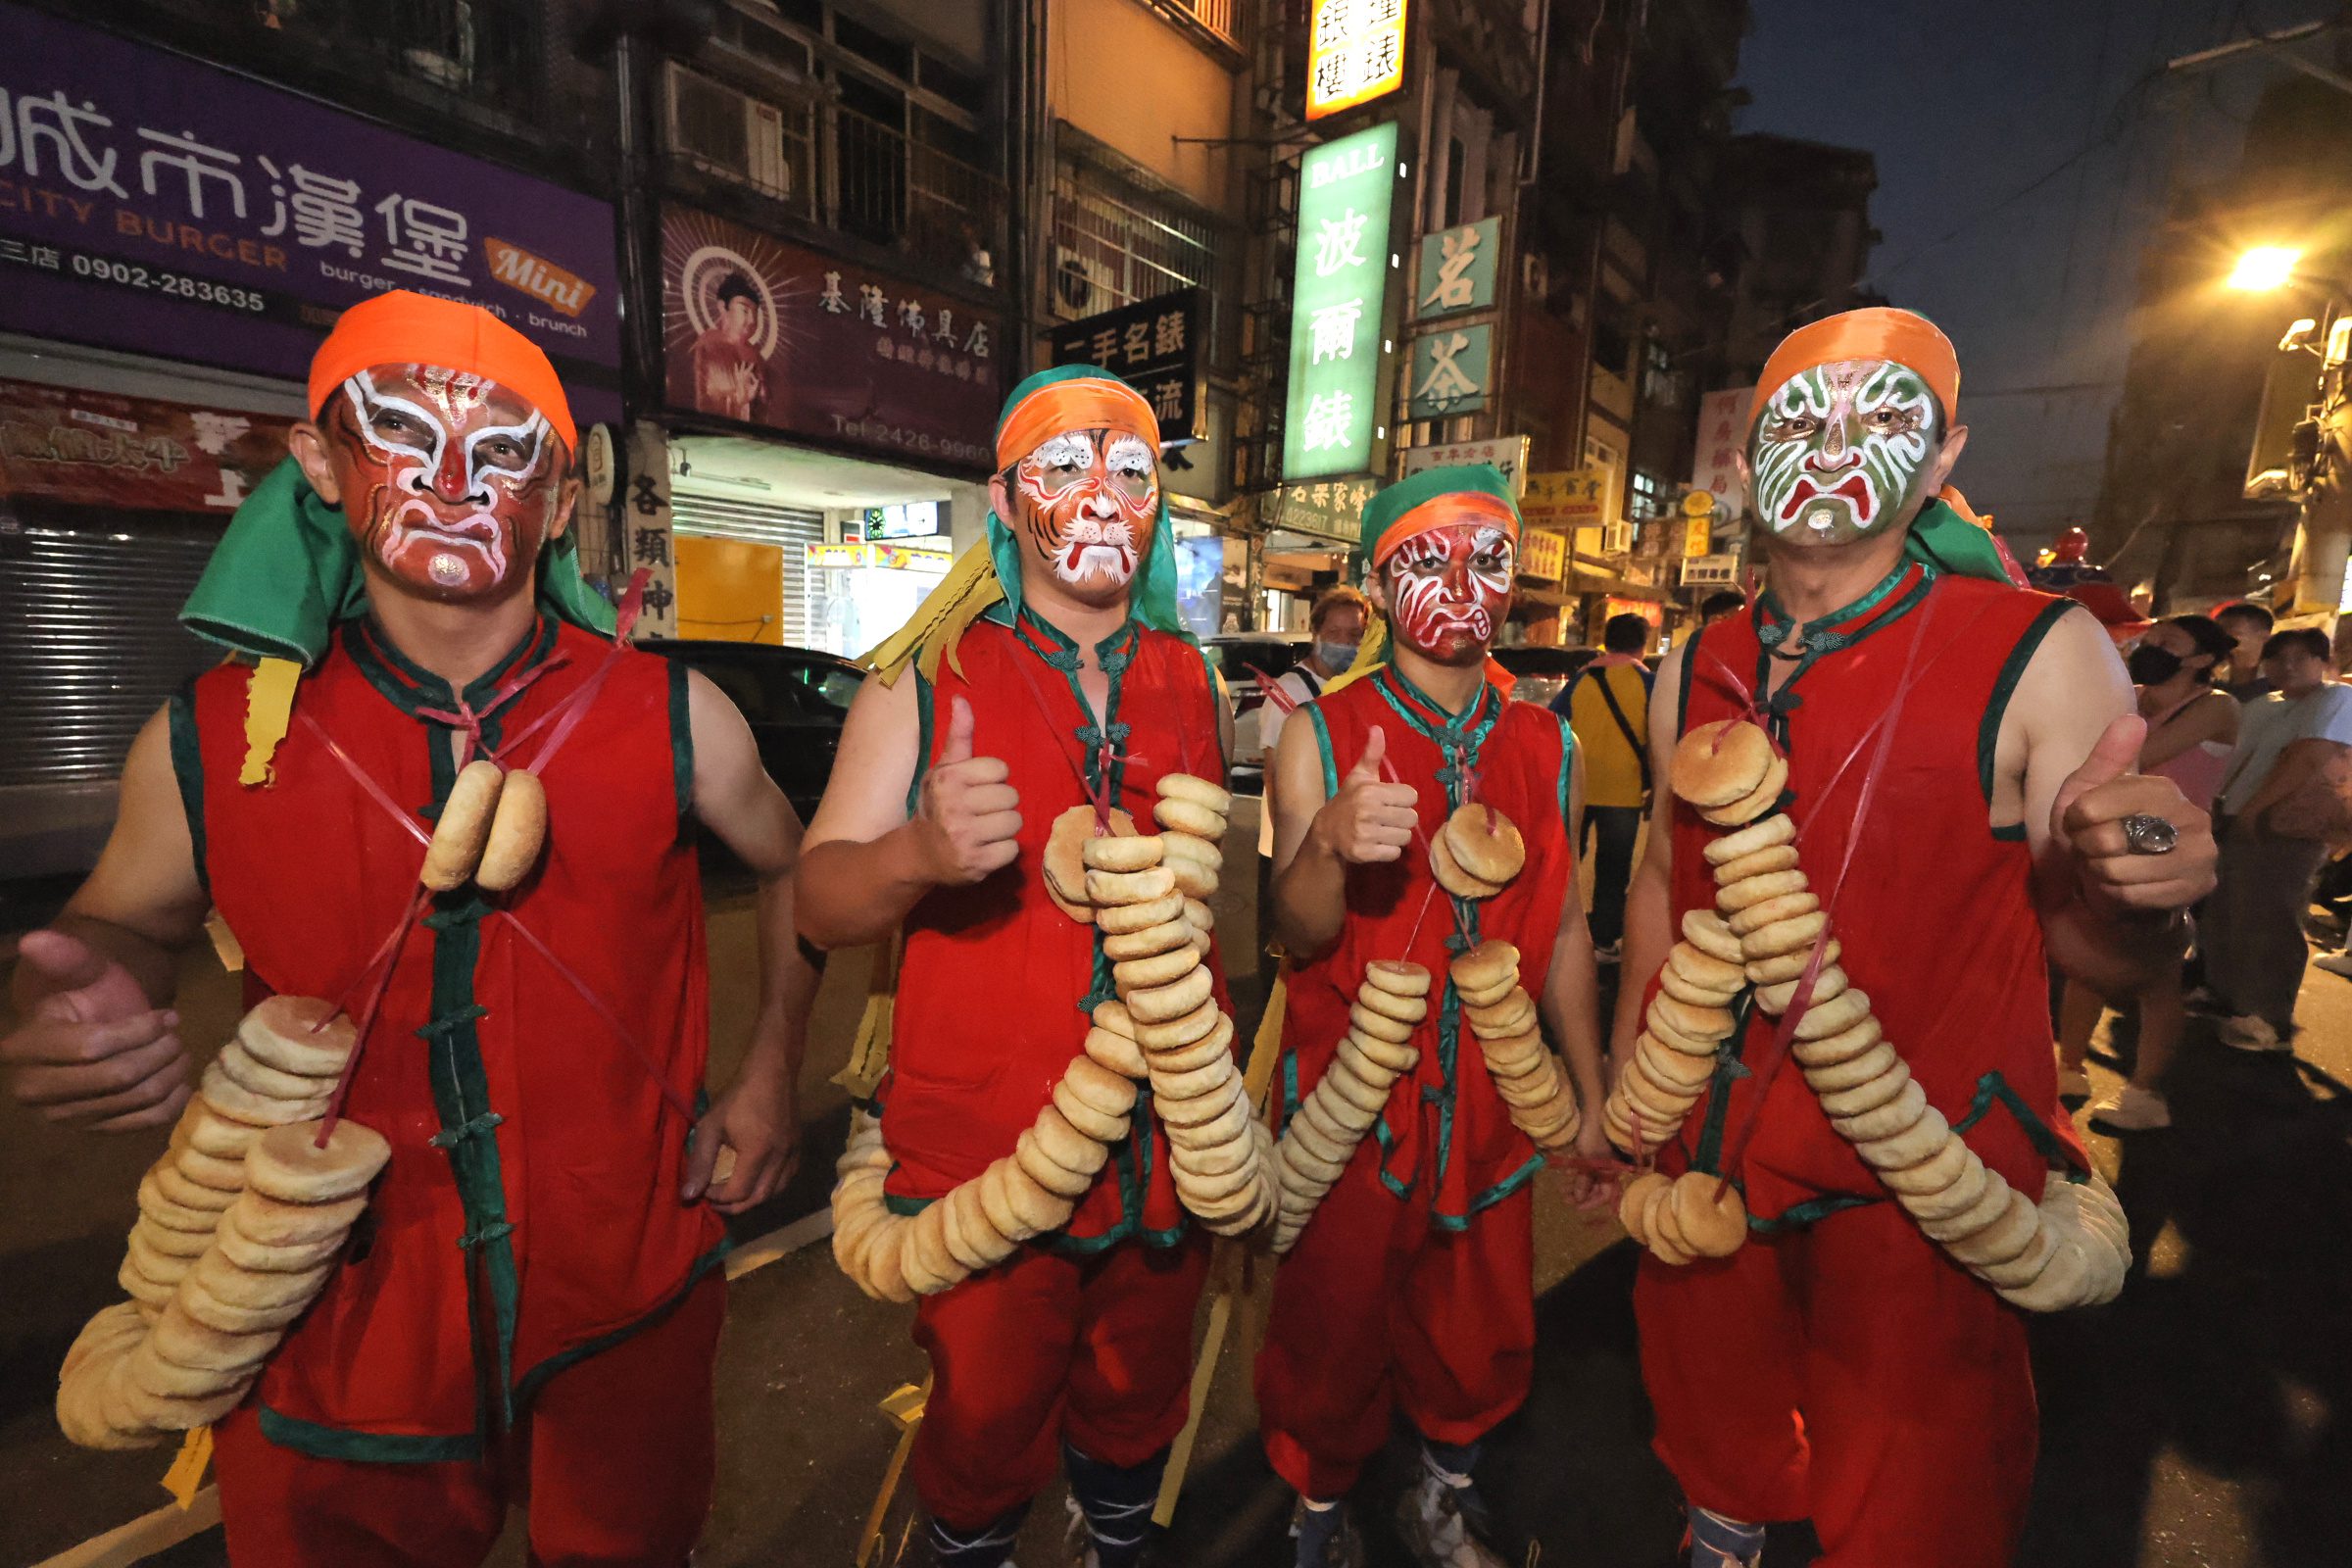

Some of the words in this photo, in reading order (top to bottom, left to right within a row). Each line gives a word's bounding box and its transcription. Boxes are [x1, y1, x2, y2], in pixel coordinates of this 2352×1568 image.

[1310, 143, 1385, 189] BALL
[114, 207, 288, 273] BURGER
[72, 254, 266, 313] 0902-283635
[319, 261, 396, 291] burger
[529, 313, 587, 337] brunch
[497, 248, 581, 311] Mini
[1302, 207, 1368, 452] 波爾錶
[1415, 225, 1483, 412] 茗茶
[632, 473, 673, 638] 各類神
